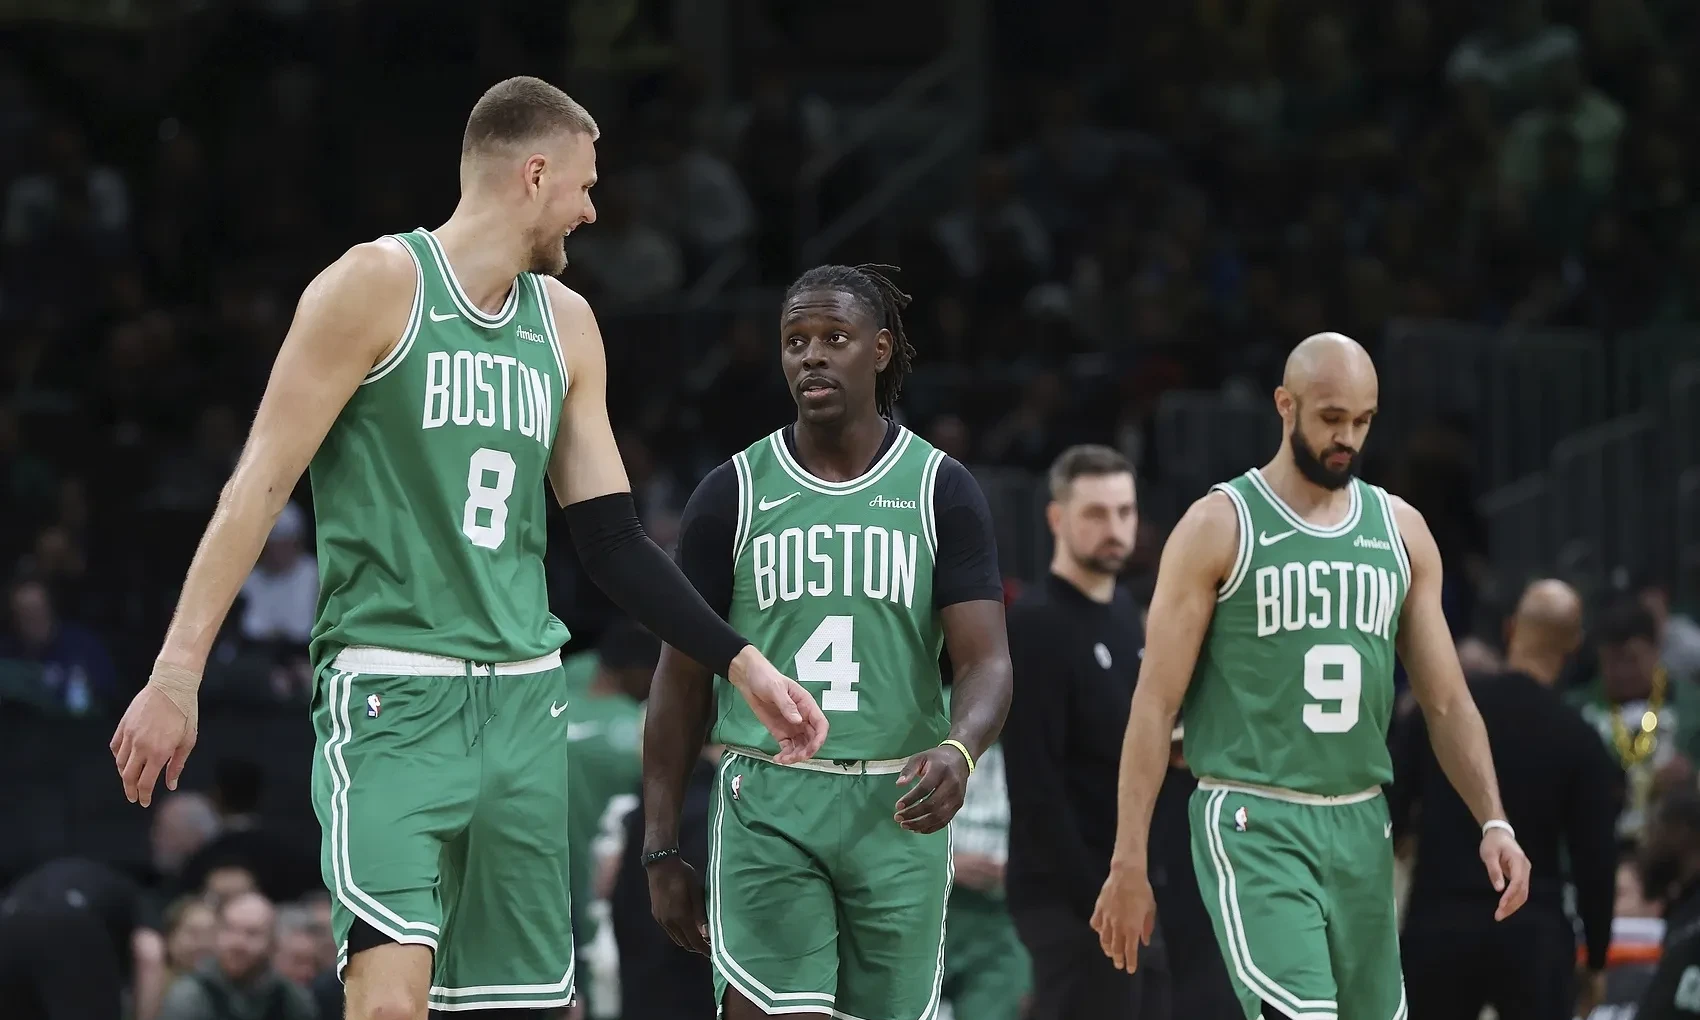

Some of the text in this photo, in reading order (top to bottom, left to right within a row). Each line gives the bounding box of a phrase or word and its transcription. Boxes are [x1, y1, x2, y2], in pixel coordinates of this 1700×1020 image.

[516, 324, 545, 344] Amica
[422, 351, 552, 449] BOSTON
[463, 447, 517, 550] 8
[869, 495, 916, 509] Amica
[753, 524, 917, 611] BOSTON
[1353, 535, 1391, 550] Amica
[1256, 560, 1397, 640] BOSTON
[794, 615, 860, 711] 4
[1303, 644, 1361, 733] 9
